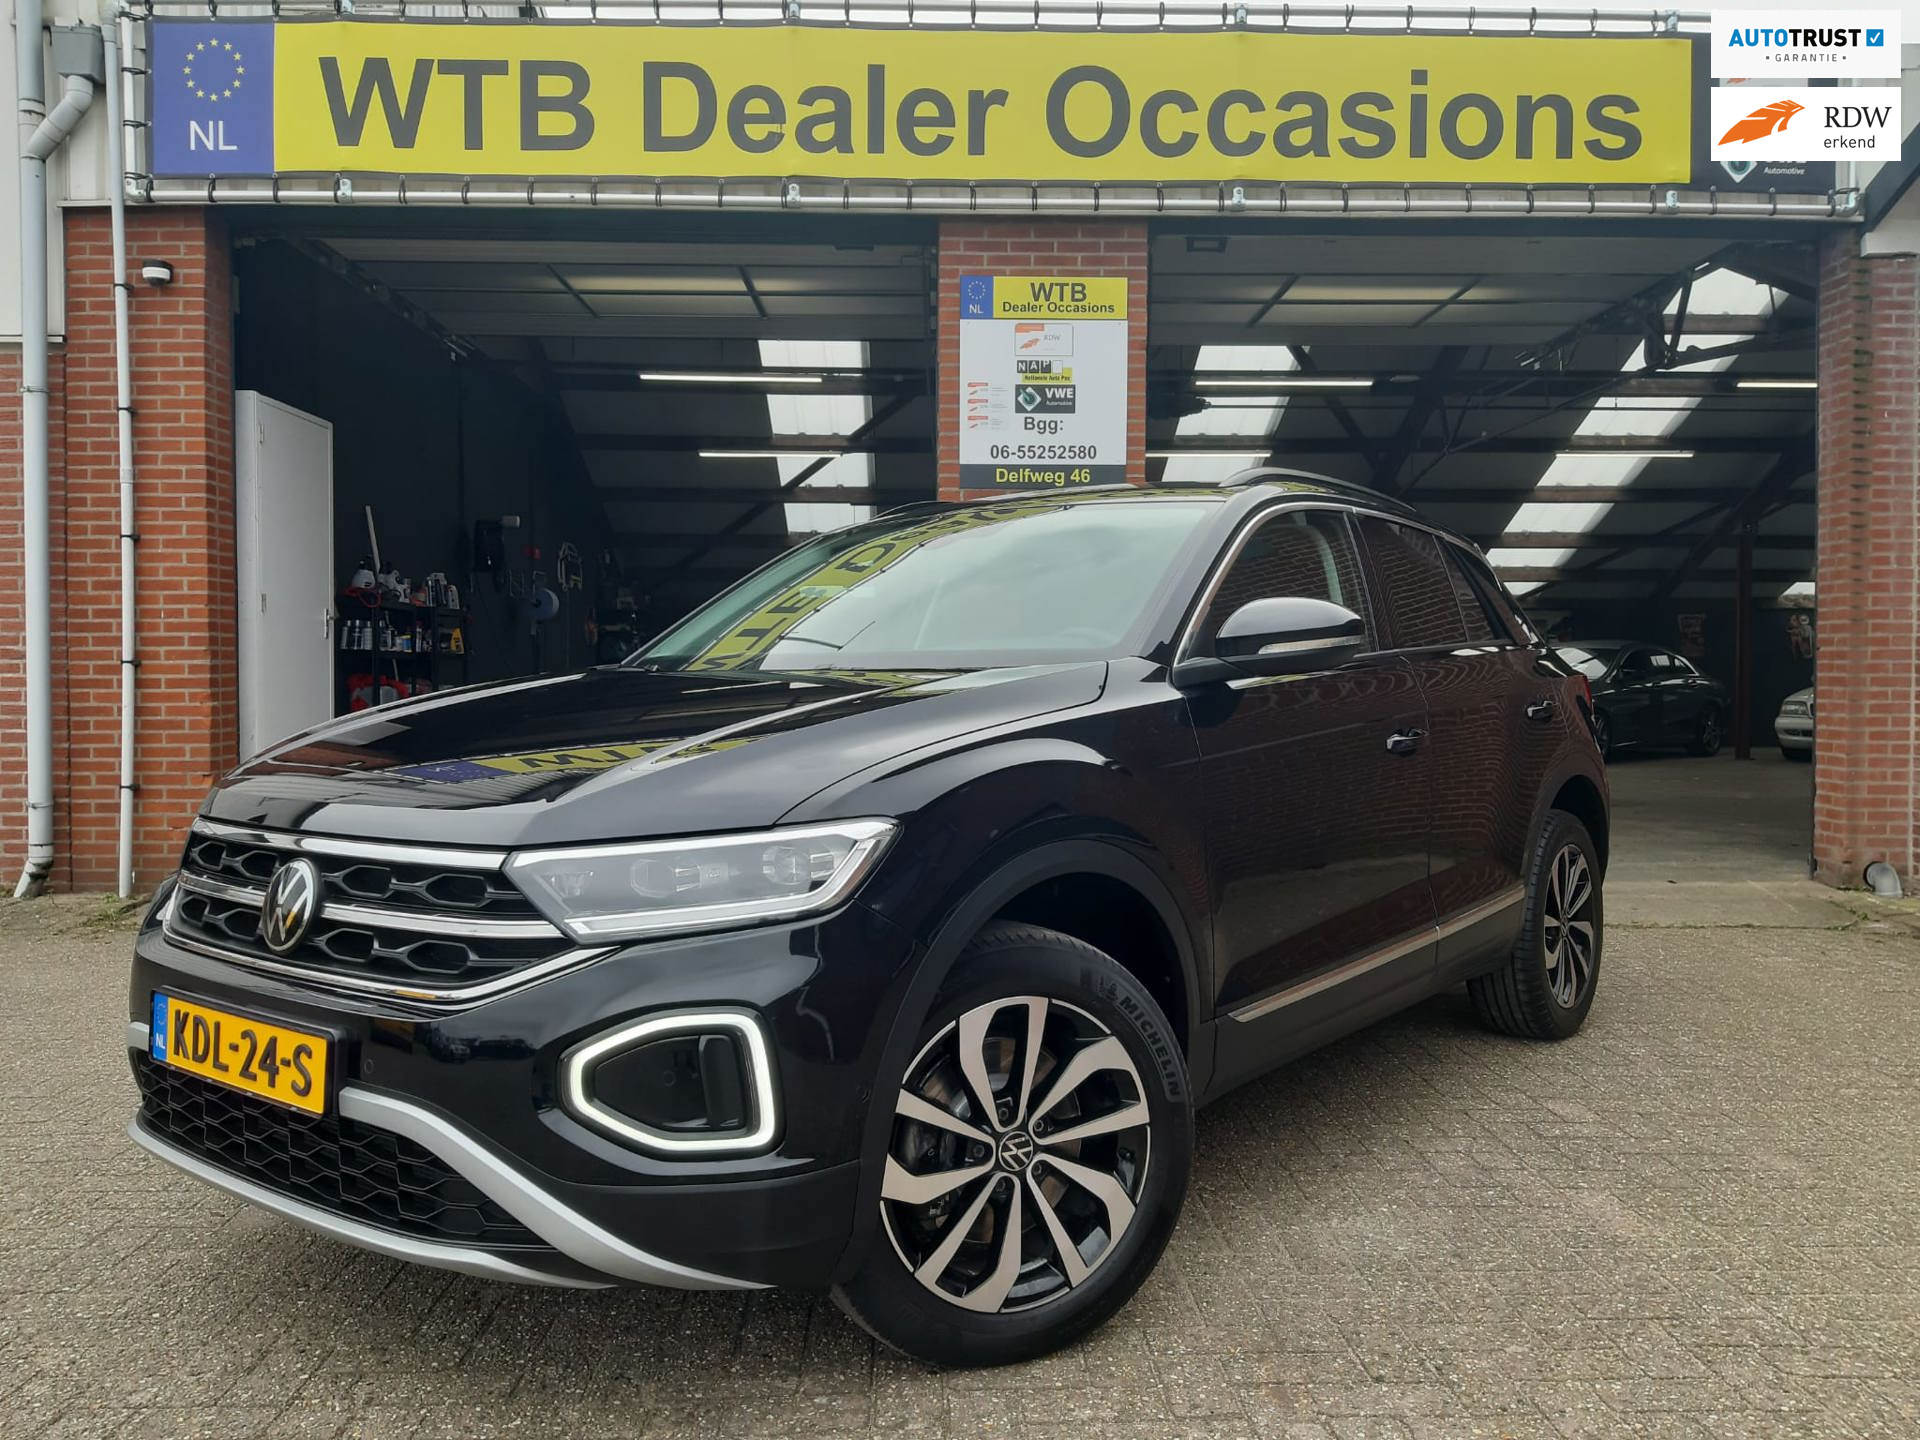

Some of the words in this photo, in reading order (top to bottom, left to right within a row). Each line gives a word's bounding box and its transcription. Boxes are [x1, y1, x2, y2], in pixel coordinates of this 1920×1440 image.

[318, 56, 596, 152] WTB
[643, 60, 1010, 157] Dealer
[1045, 64, 1643, 161] Occasions
[188, 120, 238, 152] NL
[1763, 166, 1806, 176] Automotive
[1030, 282, 1087, 302] WTB
[969, 303, 984, 314] NL
[1002, 302, 1044, 313] Dealer
[1049, 302, 1115, 313] Occasions
[1017, 360, 1050, 372] NAP
[1045, 388, 1074, 398] VWE
[1023, 416, 1064, 434] Bgg:
[990, 445, 1097, 460] 06-55252580
[995, 468, 1065, 487] Delfweg
[1070, 469, 1091, 483] 46
[155, 1032, 166, 1050] NL
[1118, 995, 1180, 1097] MICHELIN
[173, 1009, 313, 1098] KDL-24-S
